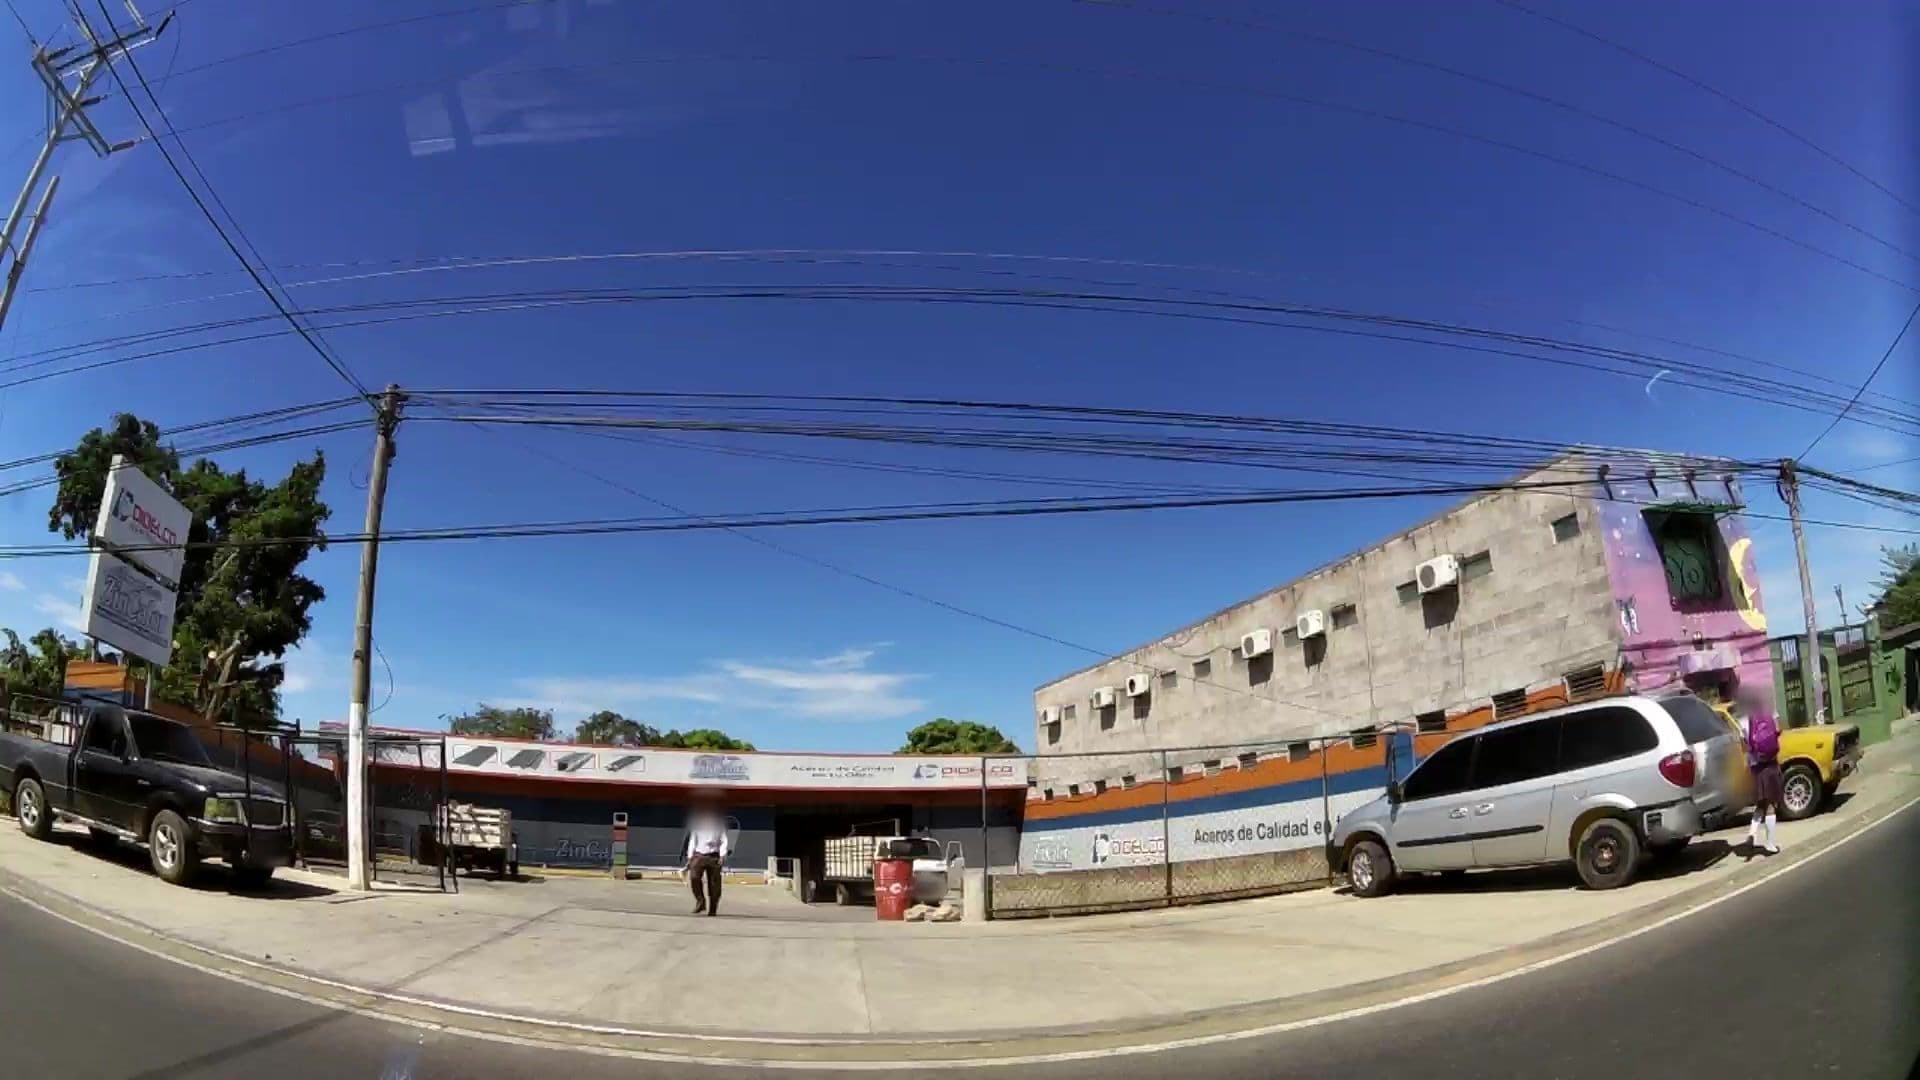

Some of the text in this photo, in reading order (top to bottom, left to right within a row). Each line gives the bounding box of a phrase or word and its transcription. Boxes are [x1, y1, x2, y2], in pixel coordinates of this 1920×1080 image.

[1194, 828, 1235, 844] Aceros
[1238, 824, 1253, 840] de
[1256, 818, 1309, 840] Calidad
